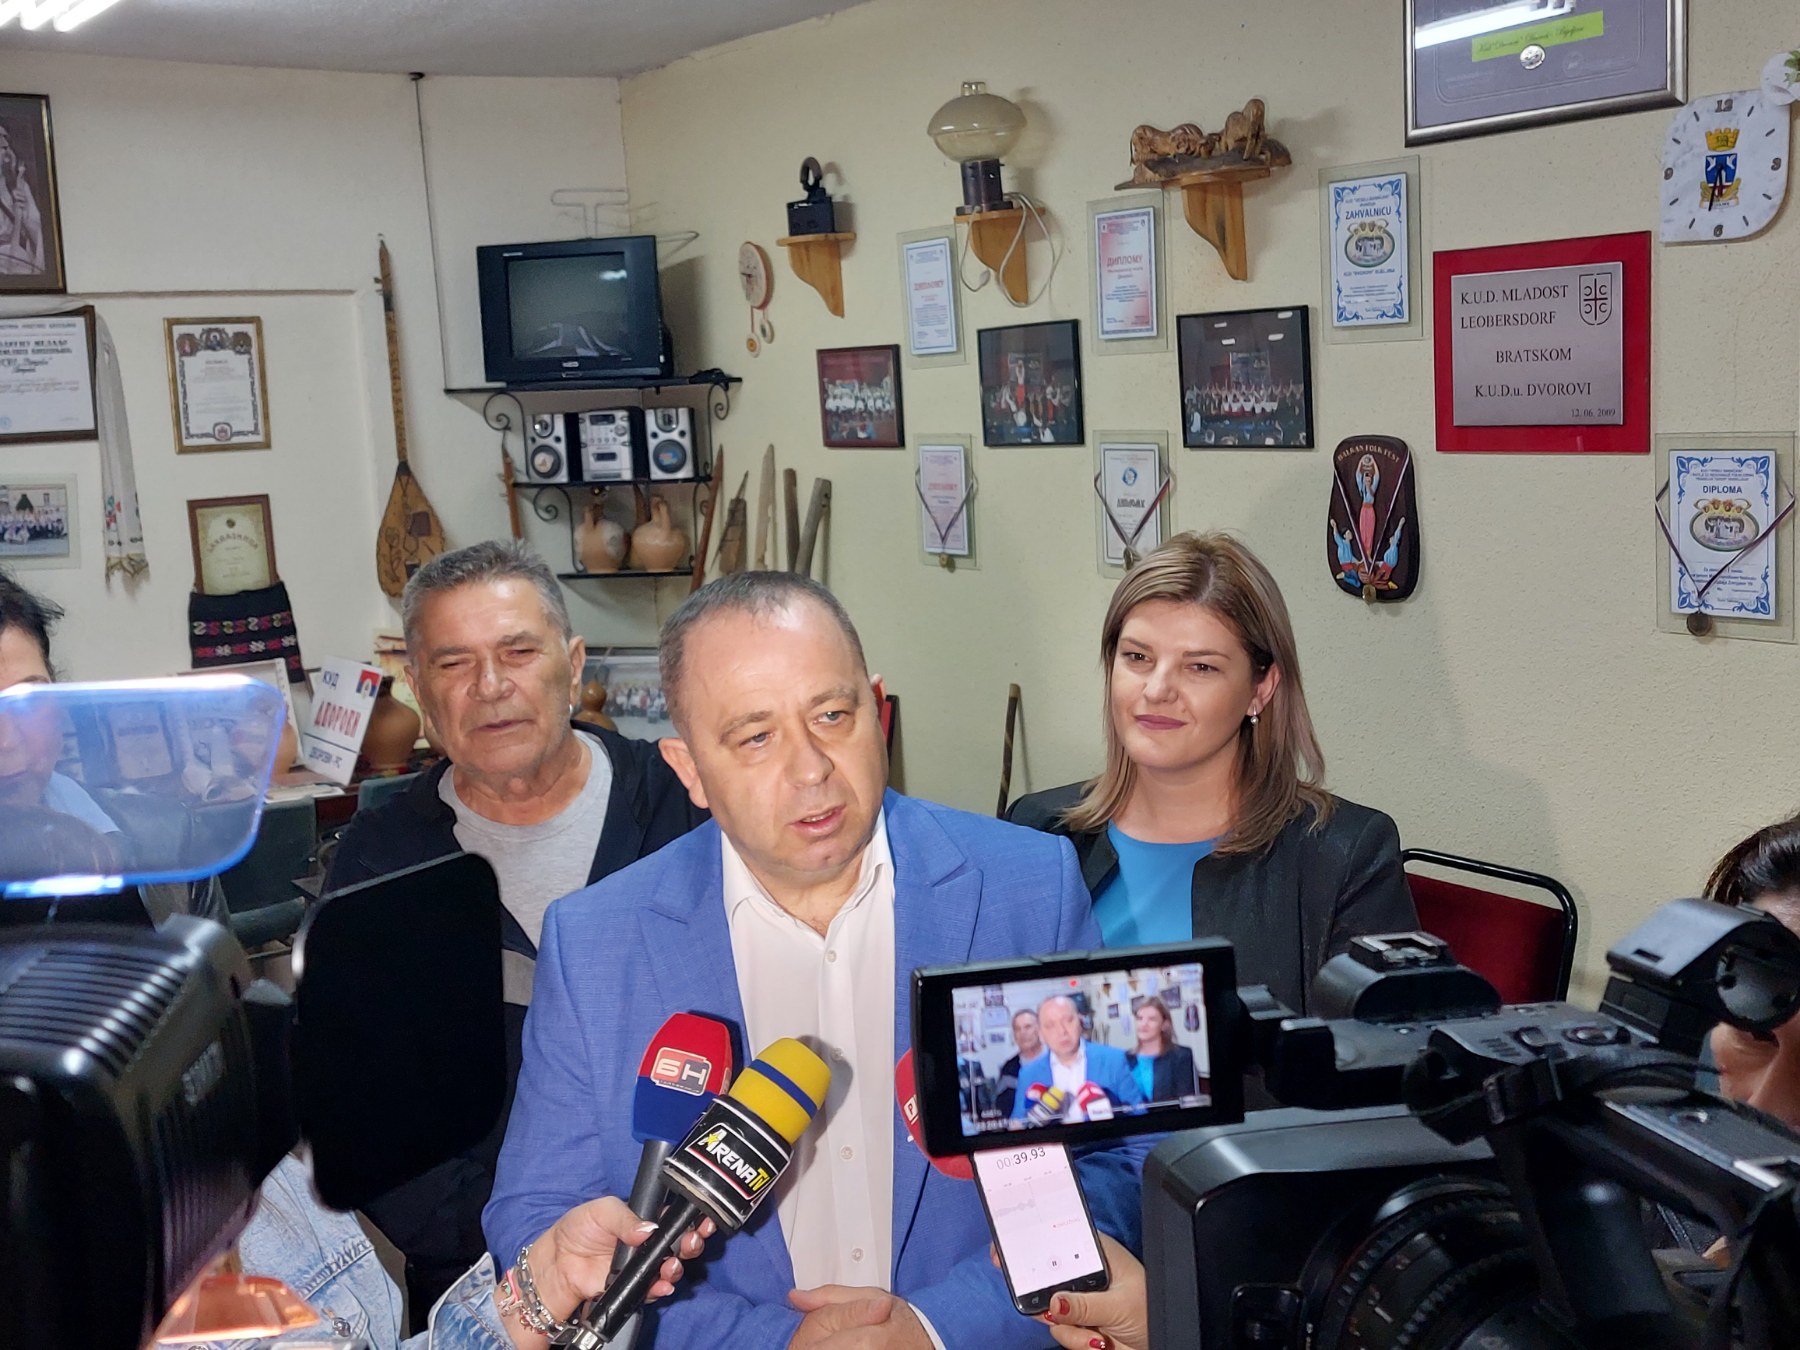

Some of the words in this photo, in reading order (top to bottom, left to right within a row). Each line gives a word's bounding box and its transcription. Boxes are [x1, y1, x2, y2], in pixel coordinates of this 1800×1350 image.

[1715, 99, 1734, 113] 12
[1771, 157, 1782, 171] 3
[1663, 167, 1674, 180] 9
[1345, 206, 1392, 220] ZAHVALNICU
[1713, 224, 1724, 237] 6
[1460, 289, 1499, 305] K.U.D.
[1502, 285, 1569, 302] MLADOST
[1460, 311, 1557, 329] LEOBERSDORF
[1496, 348, 1572, 363] BRATSKOM
[1527, 382, 1592, 396] DVOROVI
[1597, 408, 1616, 418] 2009
[1702, 485, 1743, 494] DIPLOMA
